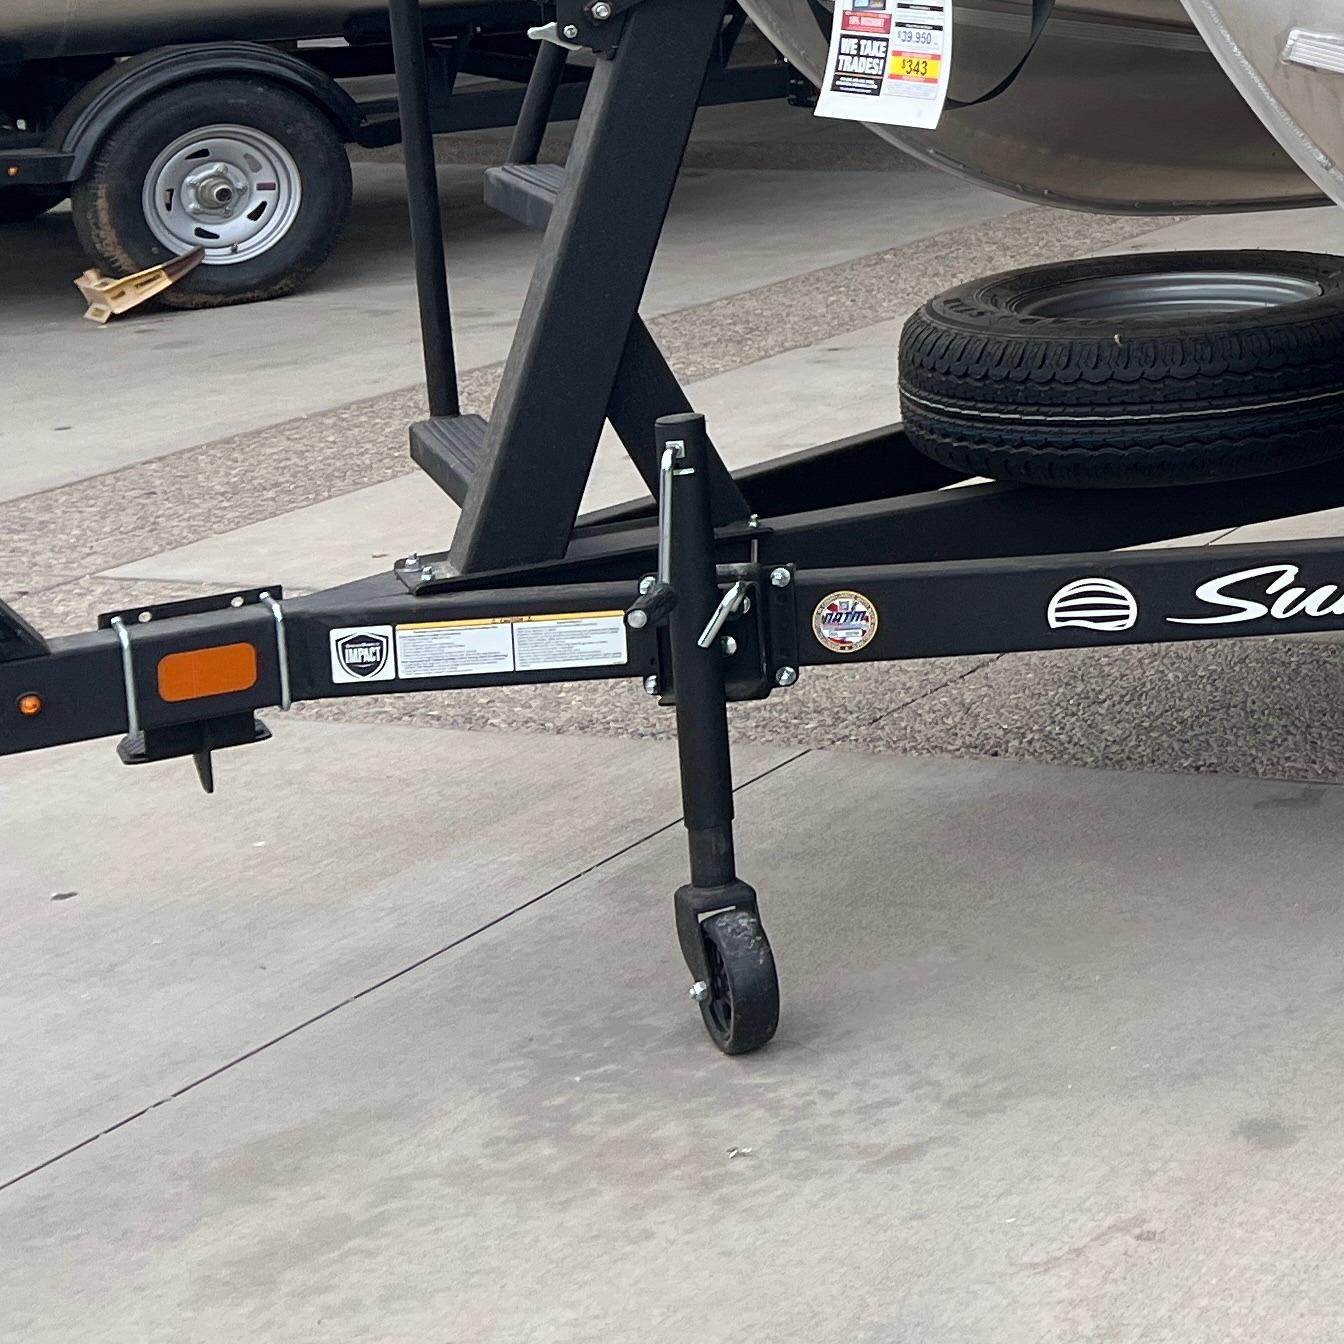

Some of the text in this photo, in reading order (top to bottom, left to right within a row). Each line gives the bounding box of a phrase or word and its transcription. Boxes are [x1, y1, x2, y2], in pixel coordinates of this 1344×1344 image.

[840, 37, 887, 59] WE TAKE
[837, 54, 884, 75] TRADES!
[901, 59, 928, 77] $343
[345, 646, 381, 664] IMPACT
